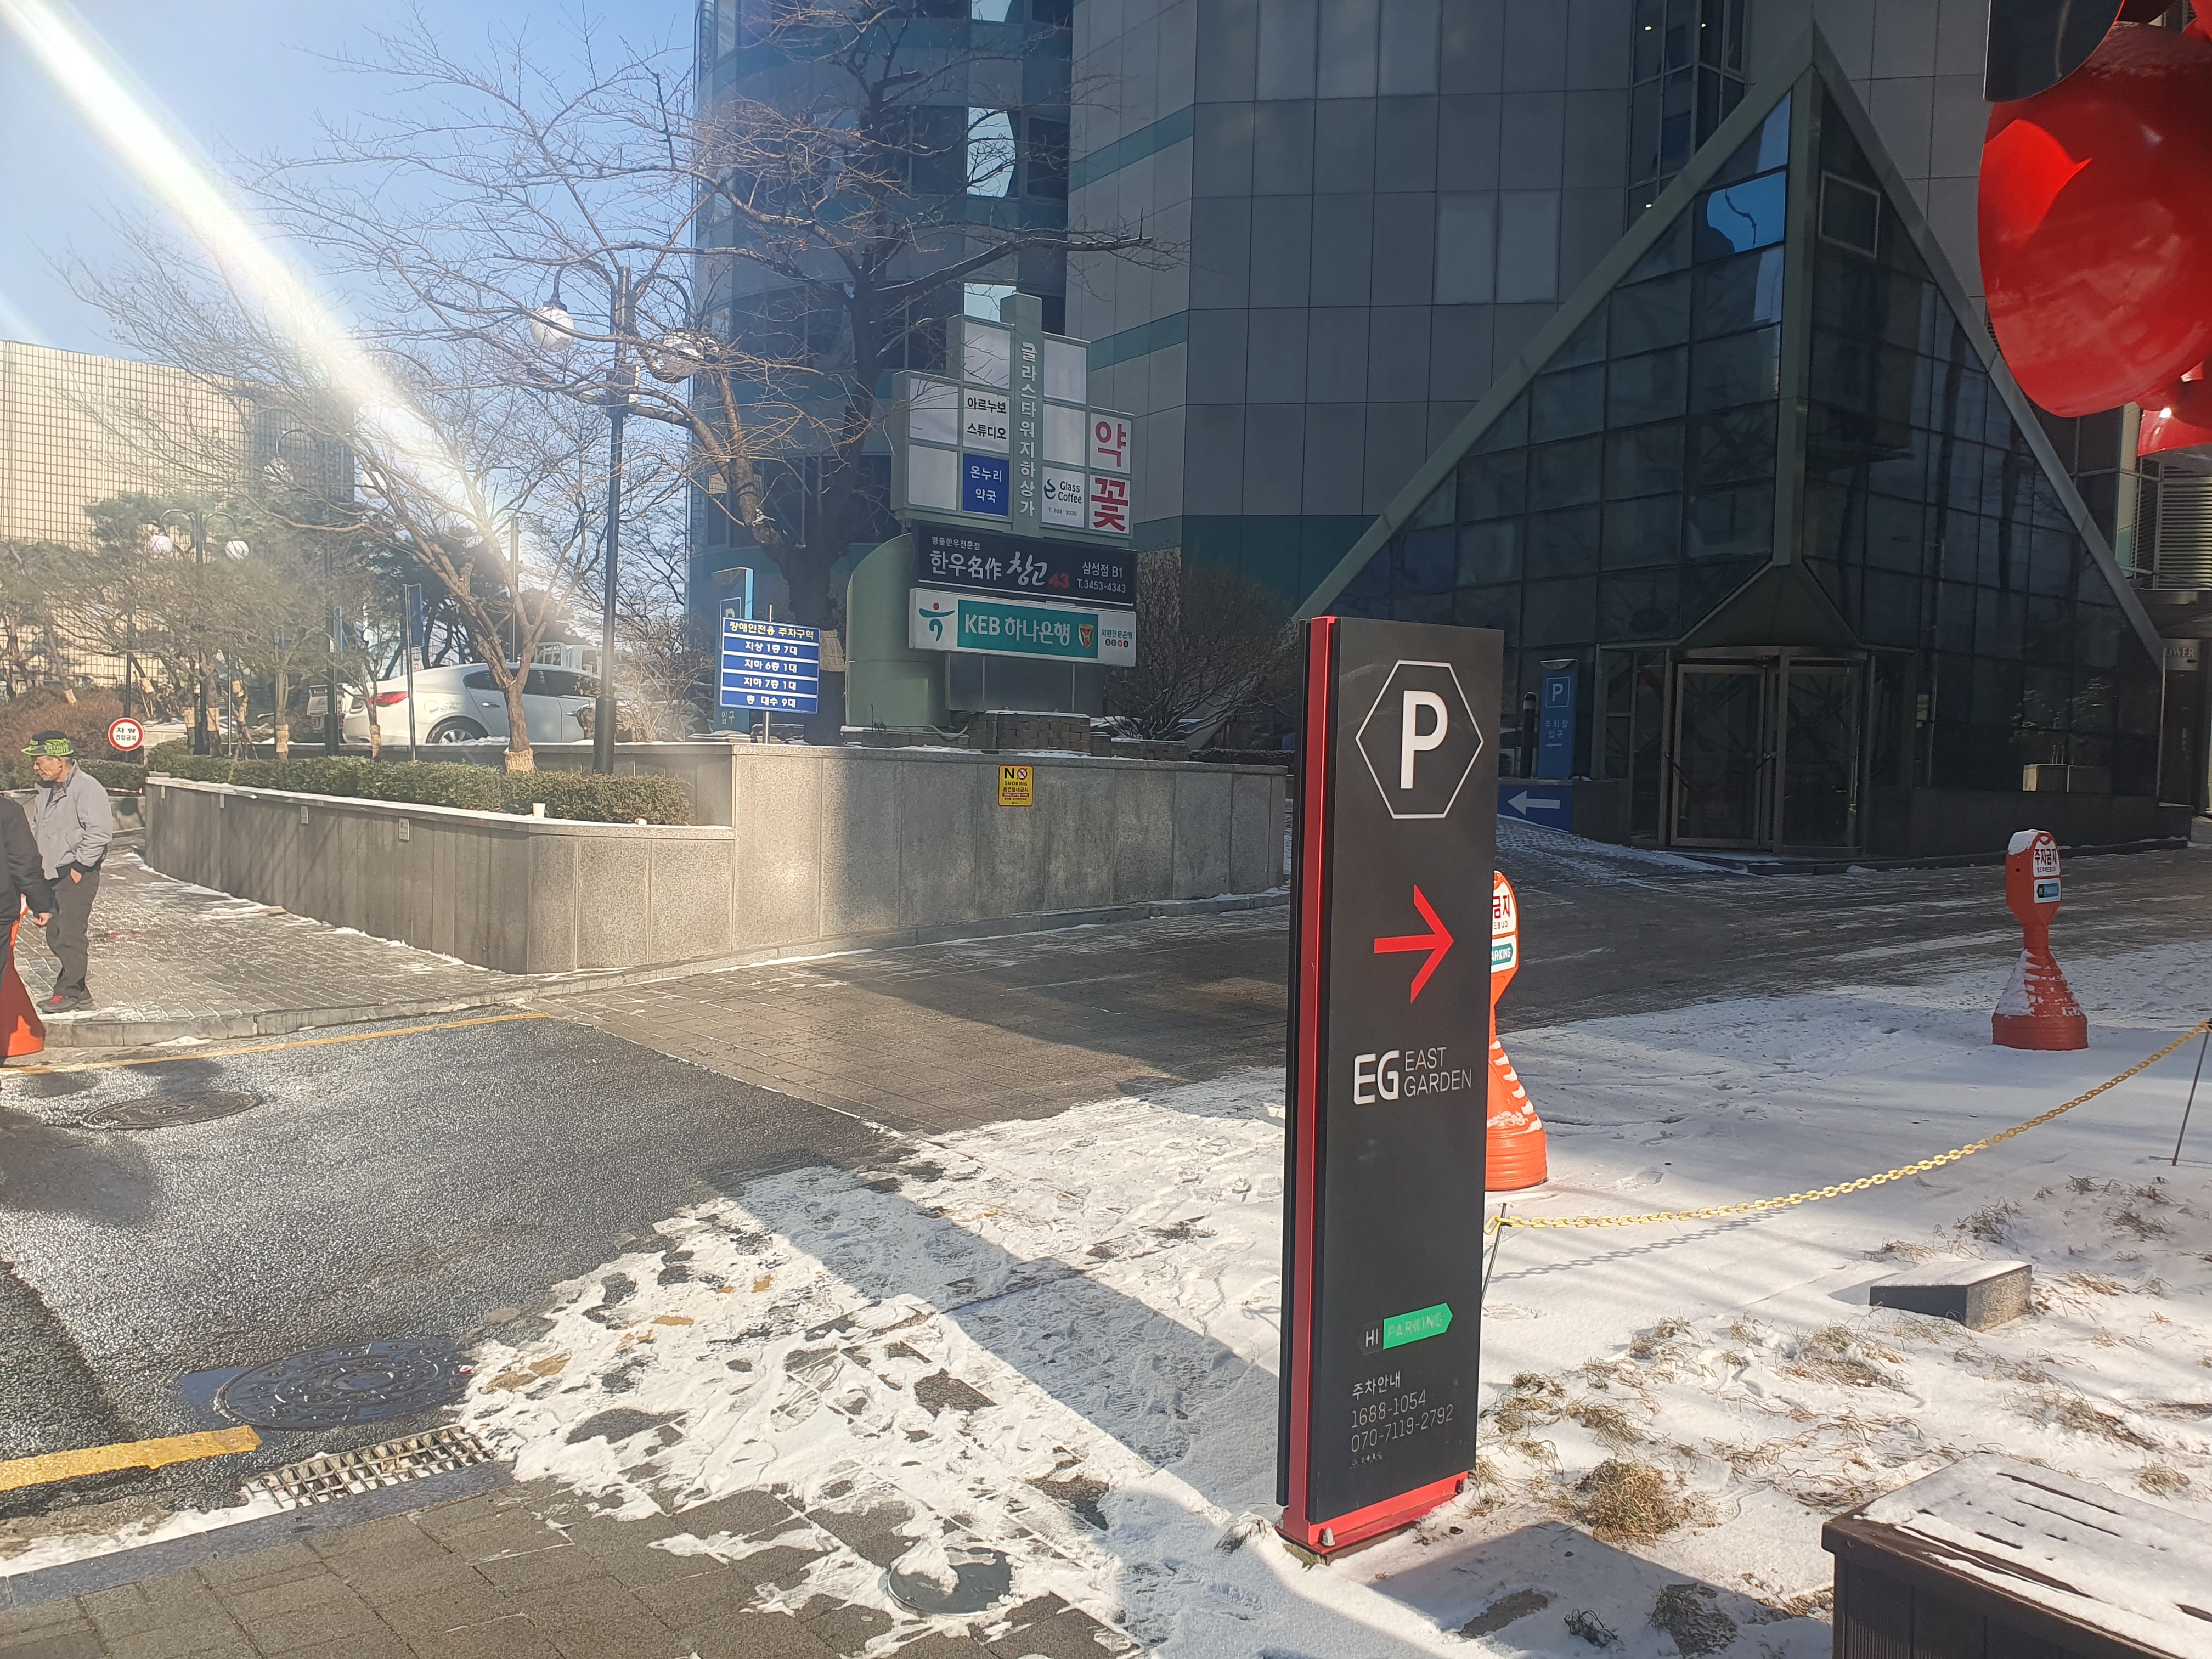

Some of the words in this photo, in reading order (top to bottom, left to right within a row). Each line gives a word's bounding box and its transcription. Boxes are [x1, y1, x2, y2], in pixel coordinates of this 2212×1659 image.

[967, 397, 1007, 414] 아르누보
[967, 424, 1007, 440] 스튜디오
[1095, 421, 1126, 467] 약
[970, 466, 1002, 483] 온누리
[1060, 481, 1080, 493] Glass
[975, 488, 996, 504] 약국
[1058, 492, 1082, 504] Coffee
[1091, 478, 1128, 532] 꽃
[932, 535, 980, 550] 명품한우전문점
[1082, 561, 1109, 578] 삼성점
[1112, 565, 1124, 578] B1
[1077, 578, 1126, 594] T.3453-4343
[730, 622, 775, 636] 장애인전용
[778, 627, 814, 640] 주차구역
[965, 614, 1000, 636] KEB
[1005, 617, 1071, 646] 하나은행
[745, 641, 764, 652] 지상
[766, 644, 780, 654] 1층
[783, 646, 798, 656] 7대
[744, 659, 763, 670] 지하
[765, 662, 780, 672] 6층
[783, 664, 797, 673] 1대
[744, 677, 763, 687] 지하
[765, 680, 779, 689] 7층
[783, 681, 797, 691] 1대
[1552, 683, 1563, 702] P
[761, 696, 778, 706] 대수
[782, 698, 796, 708] 9대
[721, 710, 735, 724] 입구
[1544, 720, 1568, 729] 주차장
[1401, 690, 1448, 789] P
[1548, 730, 1563, 738] 입구
[1353, 1050, 1399, 1105] EG
[1405, 1047, 1447, 1071] EAST
[1404, 1068, 1472, 1097] GARDEN
[1365, 1328, 1379, 1347] HI
[1387, 1311, 1444, 1341] PARKING
[1352, 1370, 1400, 1400] 주차안내
[1351, 1389, 1426, 1428] 1688-1054
[1351, 1404, 1454, 1453] 070-7119-2792
